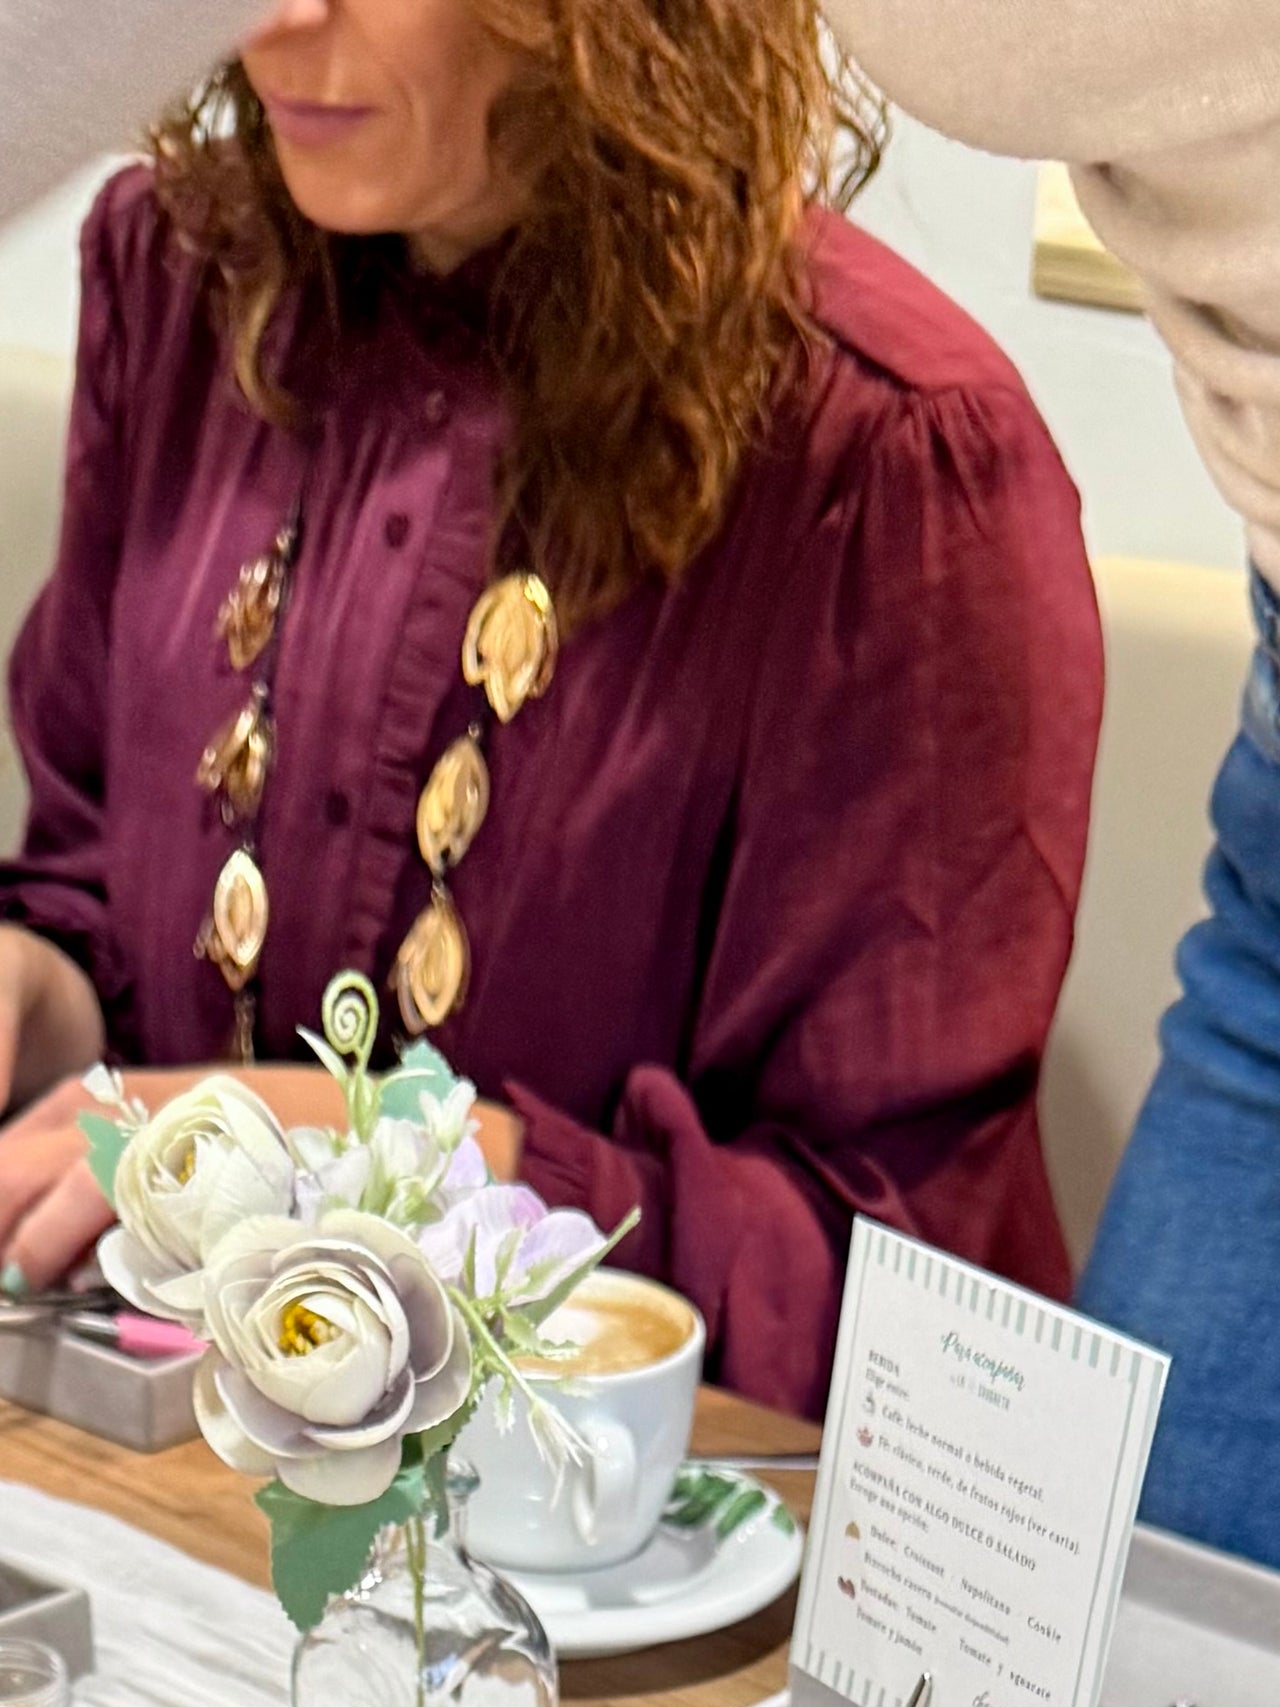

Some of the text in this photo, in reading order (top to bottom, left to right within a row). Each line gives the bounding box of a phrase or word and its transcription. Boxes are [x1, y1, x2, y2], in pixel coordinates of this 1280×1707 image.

[905, 1417, 930, 1440] leche
[931, 1435, 964, 1460] normal
[965, 1452, 972, 1464] o
[974, 1453, 1005, 1482] bebida
[879, 1496, 896, 1514] una
[902, 1488, 923, 1508] CON
[924, 1500, 950, 1524] ALGO
[952, 1516, 984, 1544] DULCE
[985, 1535, 994, 1548] O
[995, 1541, 1036, 1571] SALADO
[956, 1478, 968, 1495] de
[970, 1485, 999, 1511] frutos
[1000, 1504, 1026, 1525] rojos
[1027, 1516, 1047, 1537] (ver
[906, 1606, 937, 1633] Tomate
[959, 1637, 992, 1666] Tomate
[997, 1663, 1004, 1676] y
[1027, 1616, 1061, 1642] Cookie
